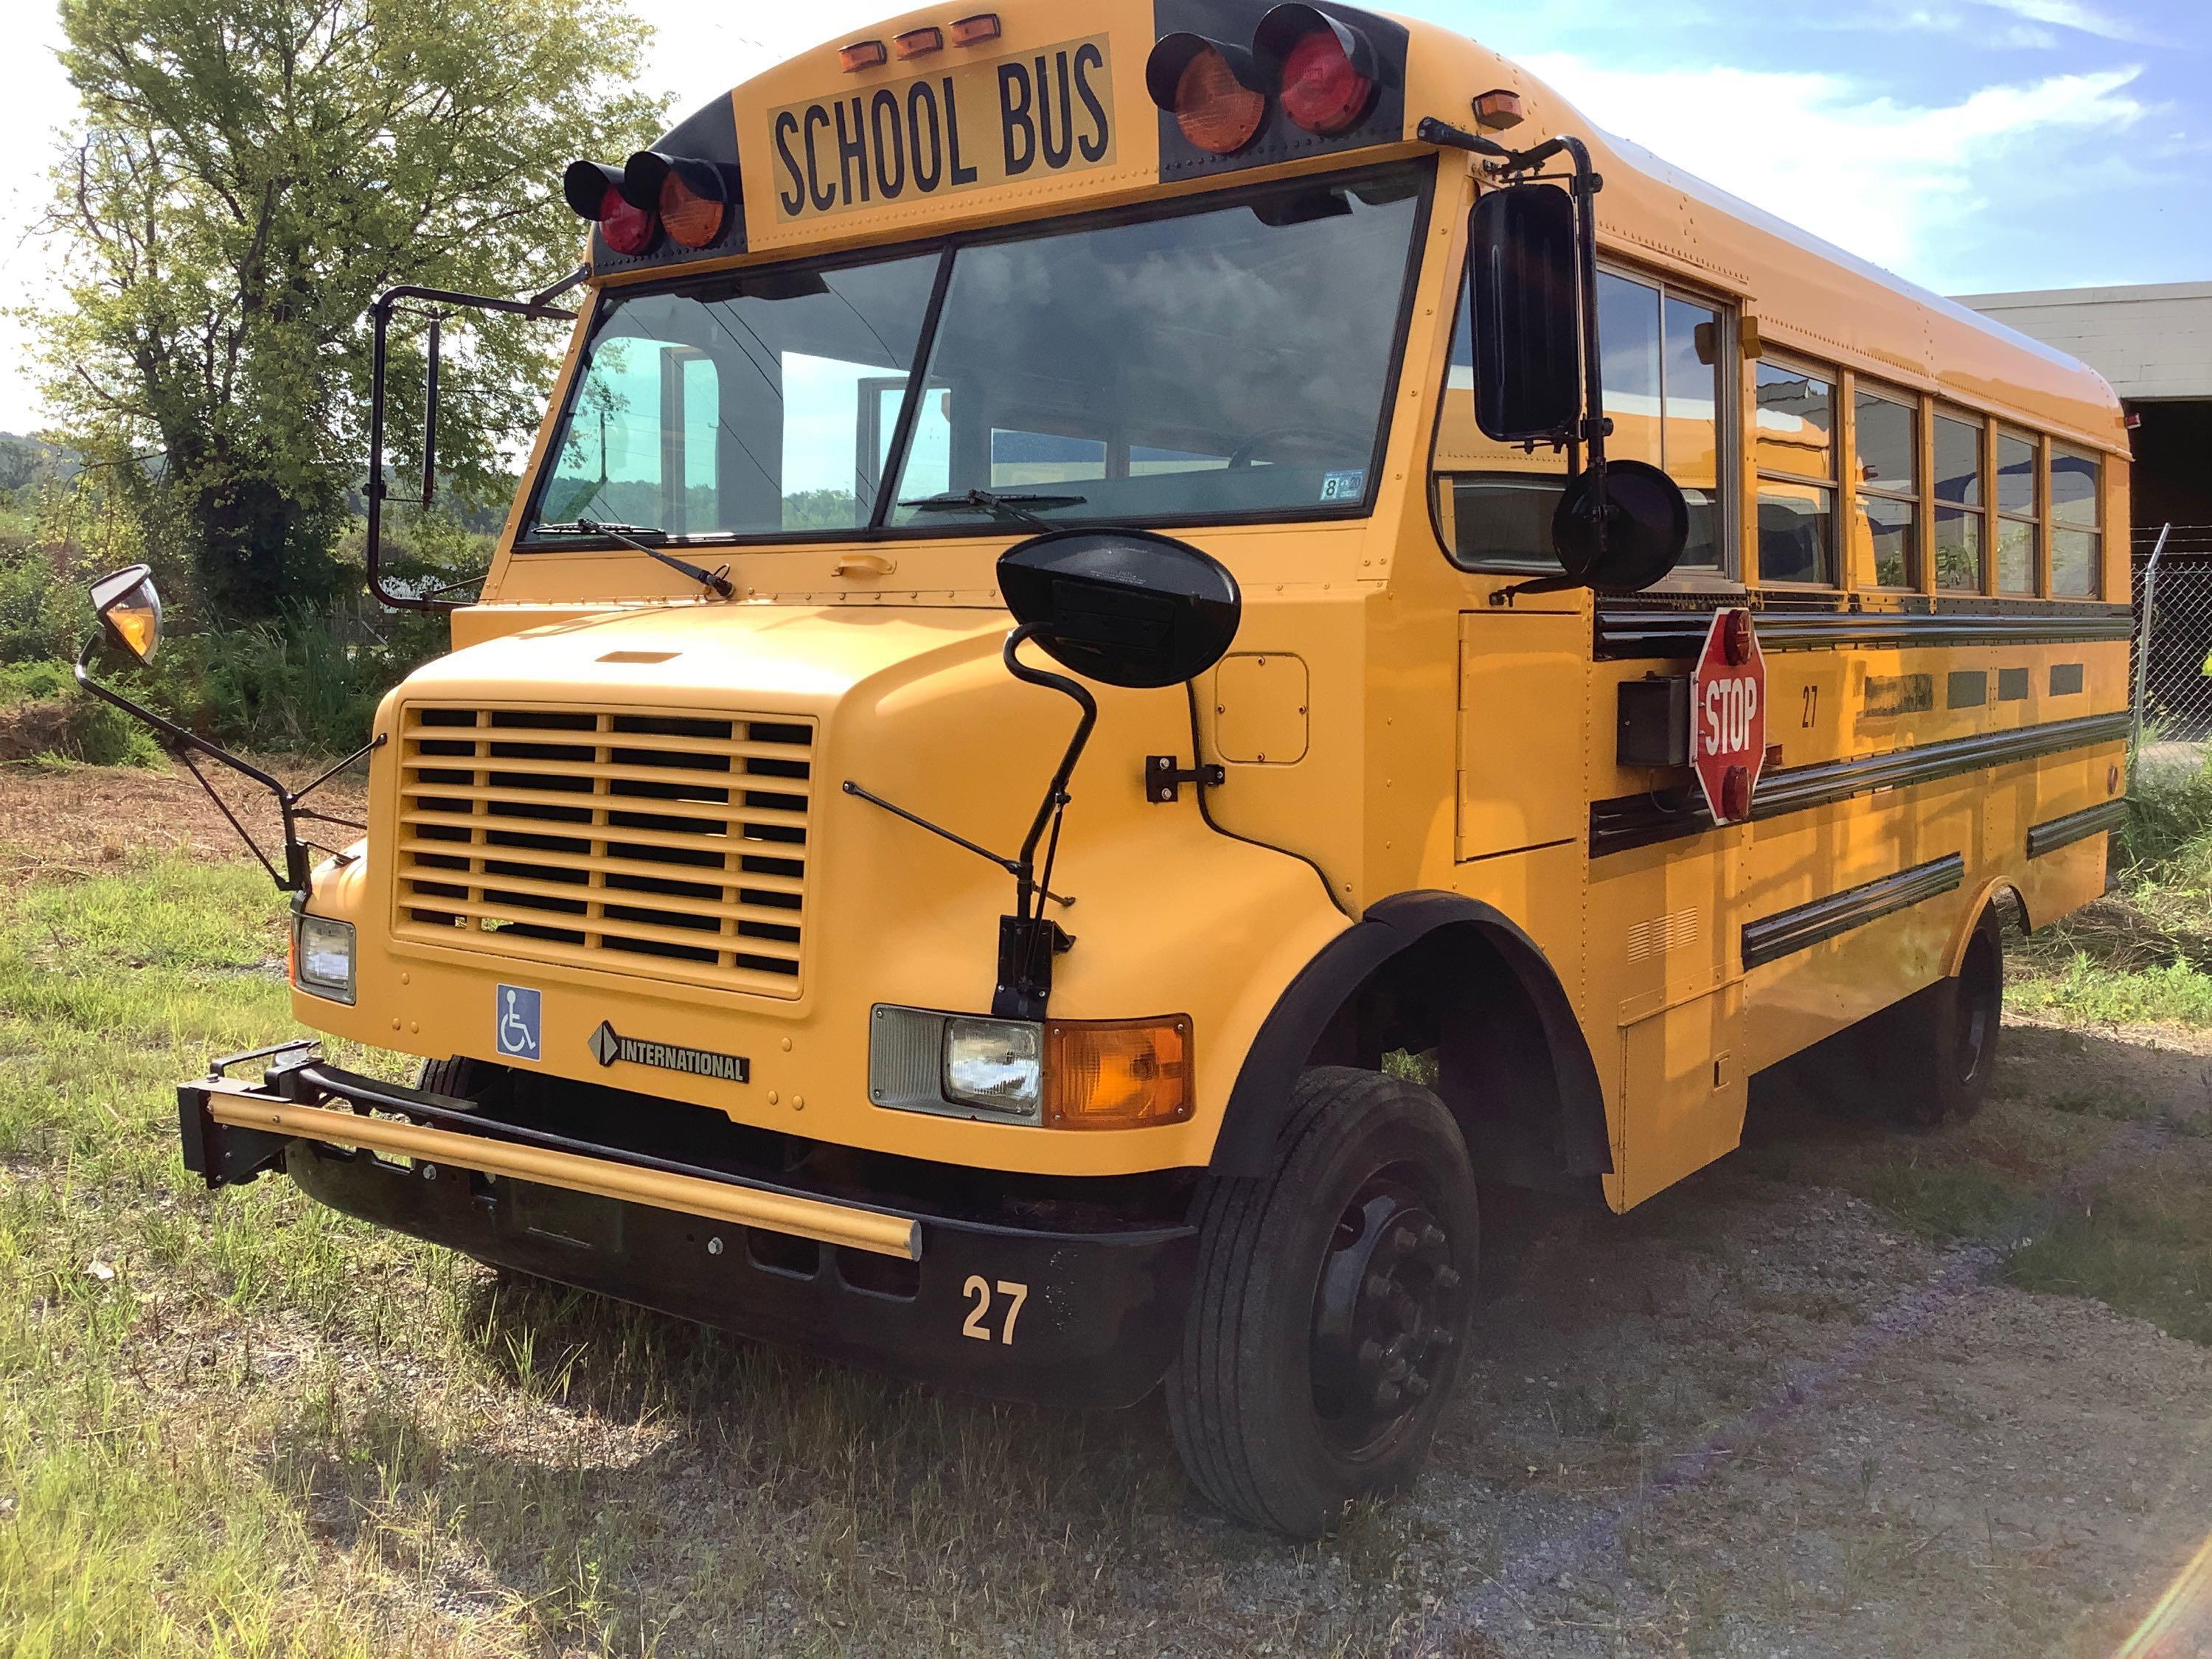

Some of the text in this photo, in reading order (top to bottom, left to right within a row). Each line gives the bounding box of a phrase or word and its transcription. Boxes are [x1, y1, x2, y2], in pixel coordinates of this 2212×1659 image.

[775, 43, 1109, 216] SCHOOL BUS
[1326, 479, 1337, 496] 8
[1705, 677, 1757, 756] STOP
[1801, 685, 1818, 728] 27
[621, 1039, 743, 1081] INTERNATIONAL
[962, 1275, 1028, 1345] 27
